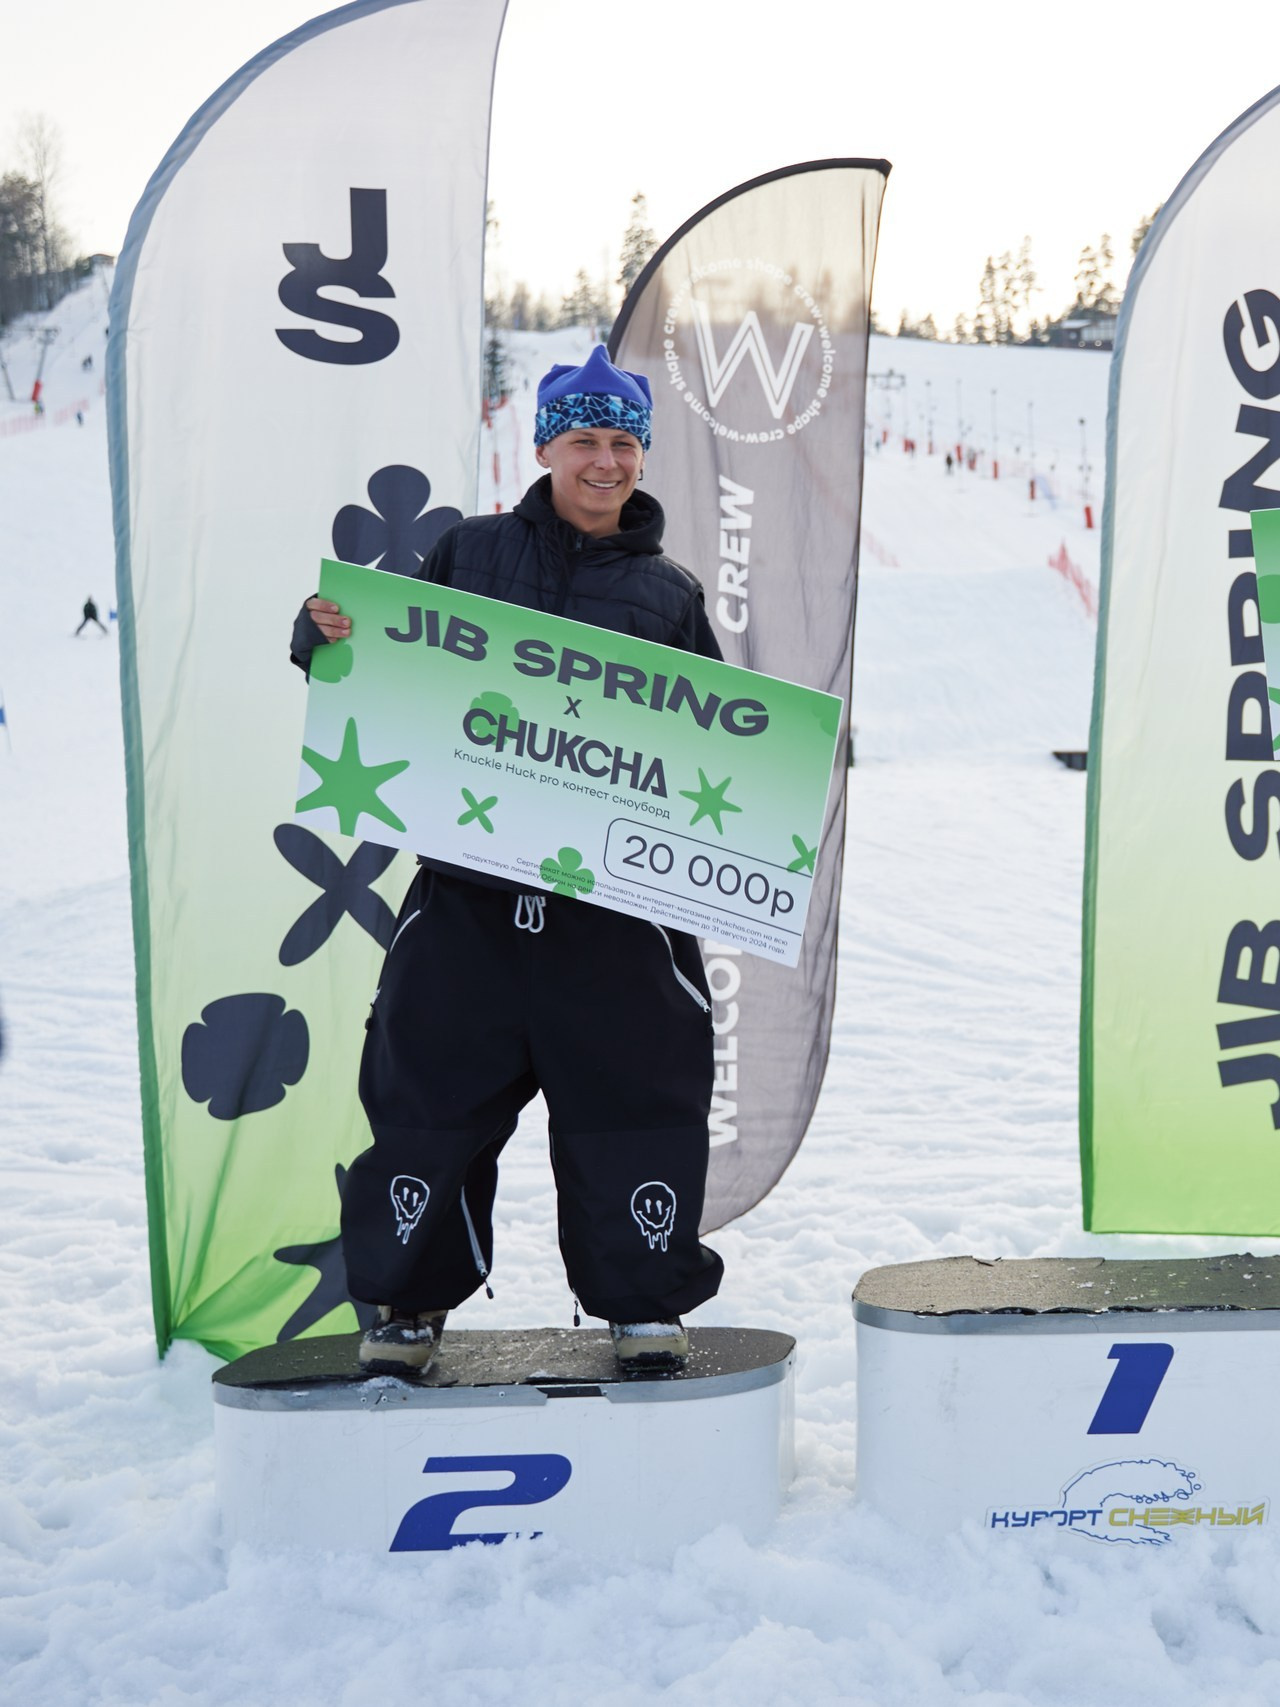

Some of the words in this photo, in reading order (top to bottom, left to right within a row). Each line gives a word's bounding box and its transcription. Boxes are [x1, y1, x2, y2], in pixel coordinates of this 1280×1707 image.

[690, 298, 815, 420] W
[716, 475, 755, 635] CREW
[384, 606, 489, 661] JIB
[513, 640, 769, 737] SPRING
[454, 748, 502, 770] Knuckle
[505, 762, 536, 780] Huck
[540, 773, 559, 787] pro
[562, 780, 609, 800] контест
[612, 794, 671, 820] сноуборд
[462, 708, 669, 798] CHUKCHA
[462, 852, 509, 870] продуктовую
[567, 881, 577, 889] на
[578, 885, 602, 896] деньги
[650, 905, 700, 927] Действителен
[701, 922, 710, 931] до
[711, 925, 719, 933] 31
[720, 929, 748, 942] августа
[749, 937, 767, 949] 2024
[516, 857, 560, 875] Сертификат
[562, 871, 586, 883] можно
[587, 878, 635, 898] использовать
[642, 896, 711, 921] интернет-магазине
[712, 916, 762, 938] chukchas.com
[774, 938, 788, 946] всю
[622, 836, 674, 875] 20
[688, 855, 794, 917] 000р
[703, 938, 742, 1148] WELCO
[1087, 1343, 1175, 1435] 1
[389, 1453, 572, 1553] 2
[991, 1509, 1103, 1529] КУРОРТ
[1108, 1502, 1266, 1527] СНЕЖНЫЙ
